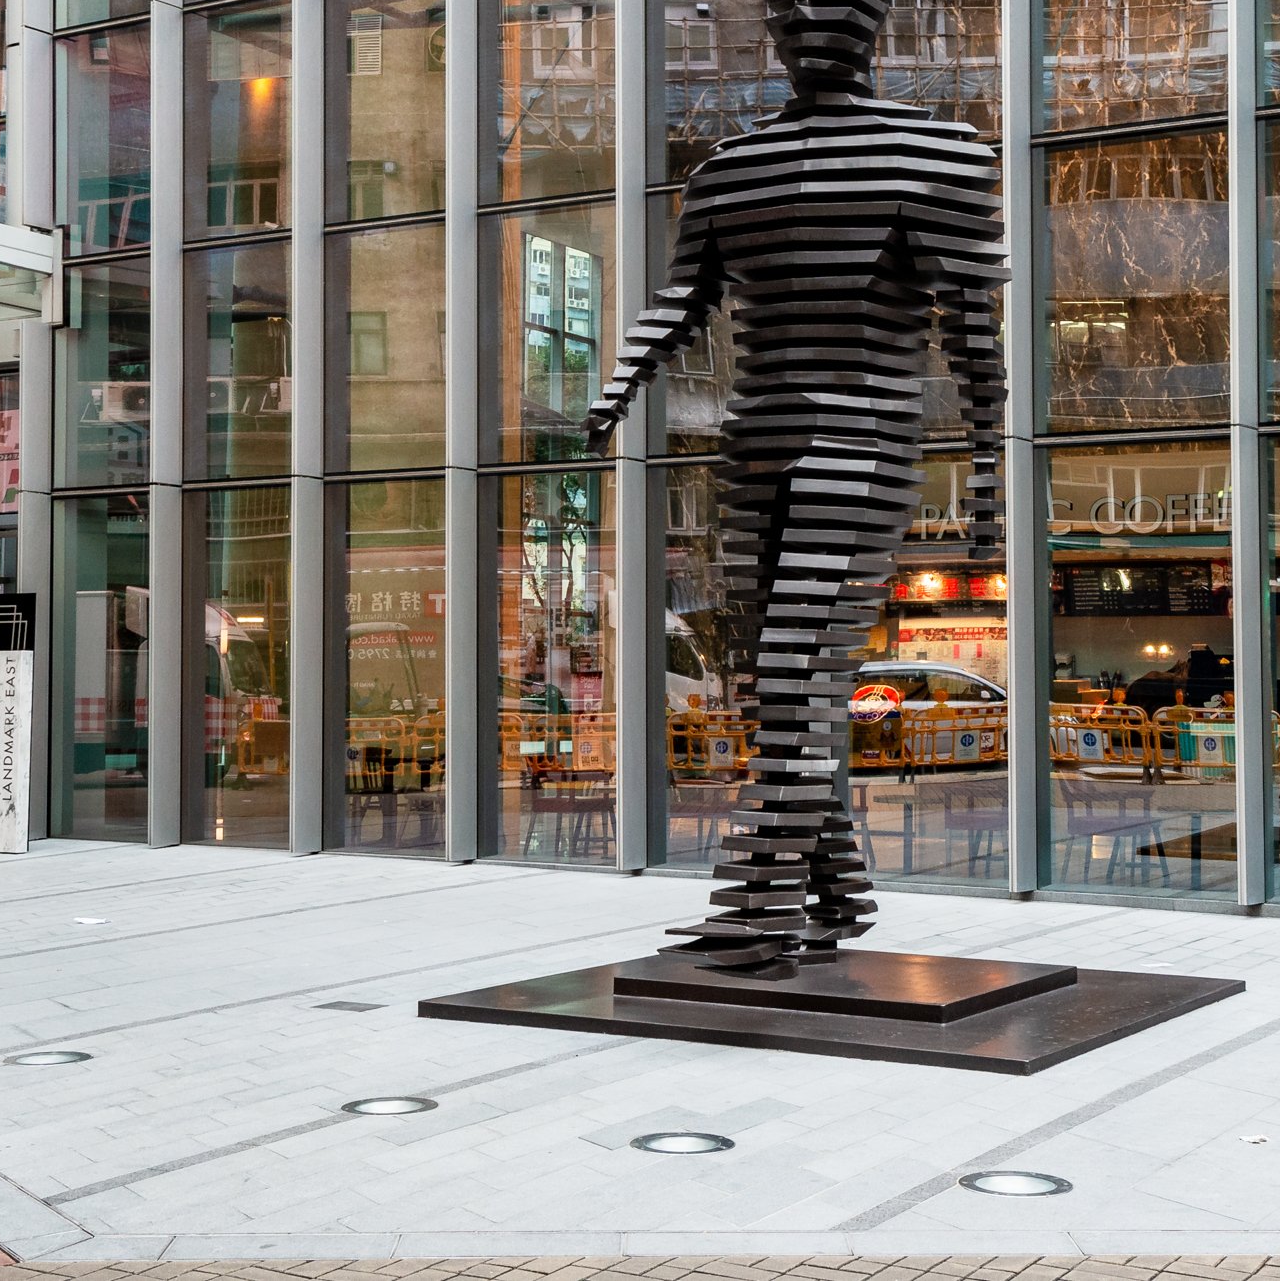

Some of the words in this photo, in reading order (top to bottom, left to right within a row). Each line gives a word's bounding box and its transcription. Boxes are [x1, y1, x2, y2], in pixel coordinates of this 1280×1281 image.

[1088, 491, 1233, 535] COFFE
[5, 656, 16, 698] EAST
[2, 705, 15, 801] LANDMARK
